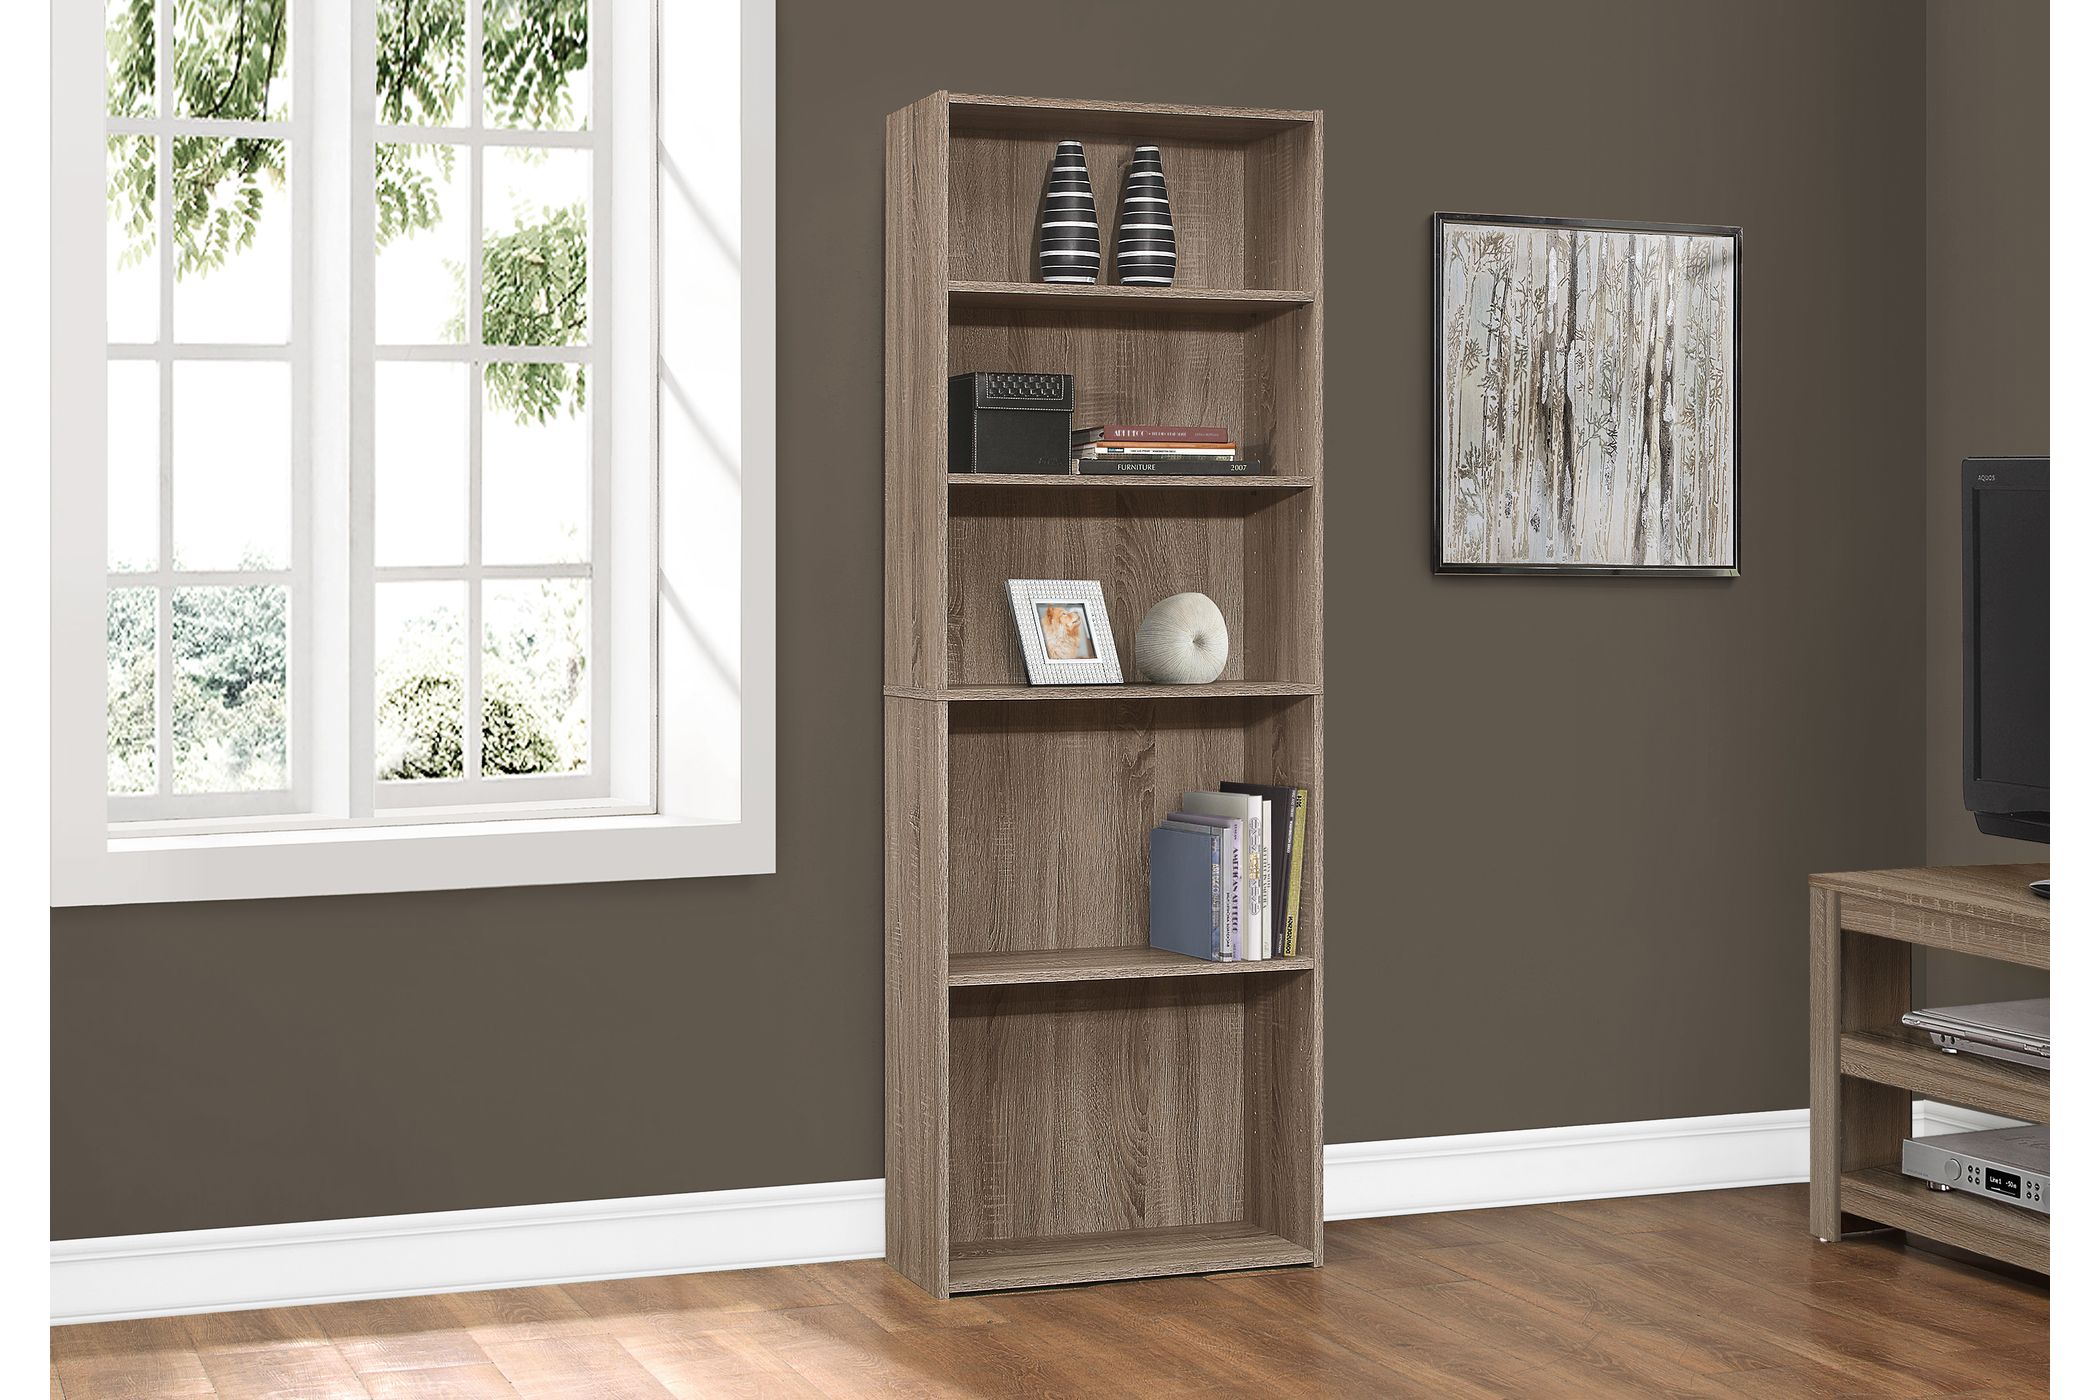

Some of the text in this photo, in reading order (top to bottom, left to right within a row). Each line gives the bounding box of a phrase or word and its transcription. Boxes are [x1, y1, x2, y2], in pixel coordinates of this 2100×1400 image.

[1117, 463, 1248, 472] FURNITURE 2007
[1977, 474, 1996, 482] AQUOS
